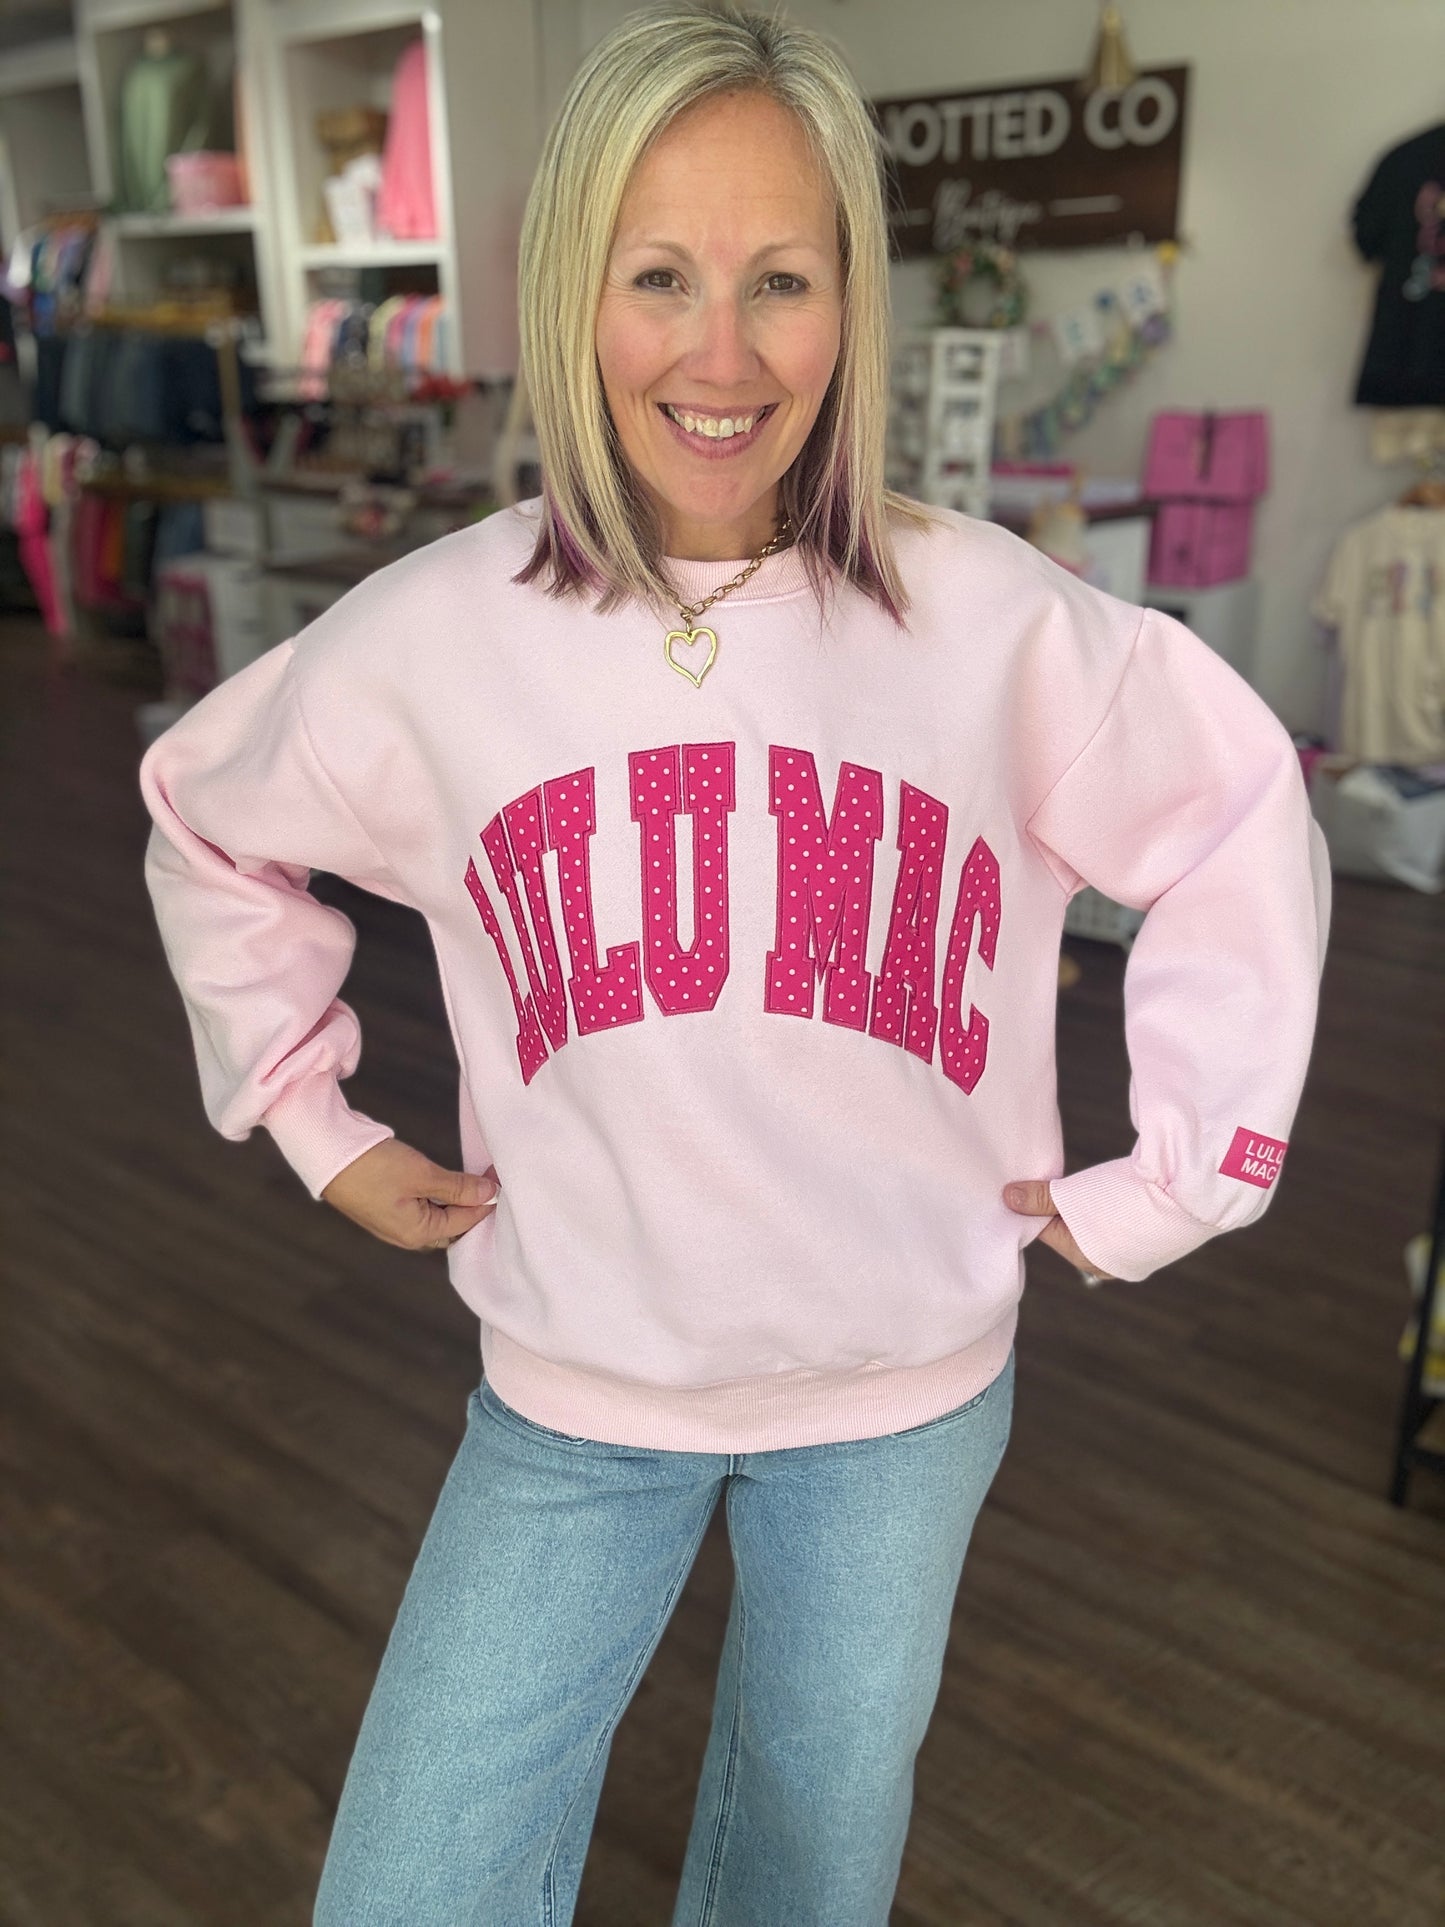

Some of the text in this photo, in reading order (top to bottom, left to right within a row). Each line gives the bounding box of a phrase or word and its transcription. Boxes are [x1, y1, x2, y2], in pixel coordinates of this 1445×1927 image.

[1083, 77, 1178, 149] CO
[464, 741, 1001, 1096] LULU MAC
[1240, 1157, 1277, 1181] MAC
